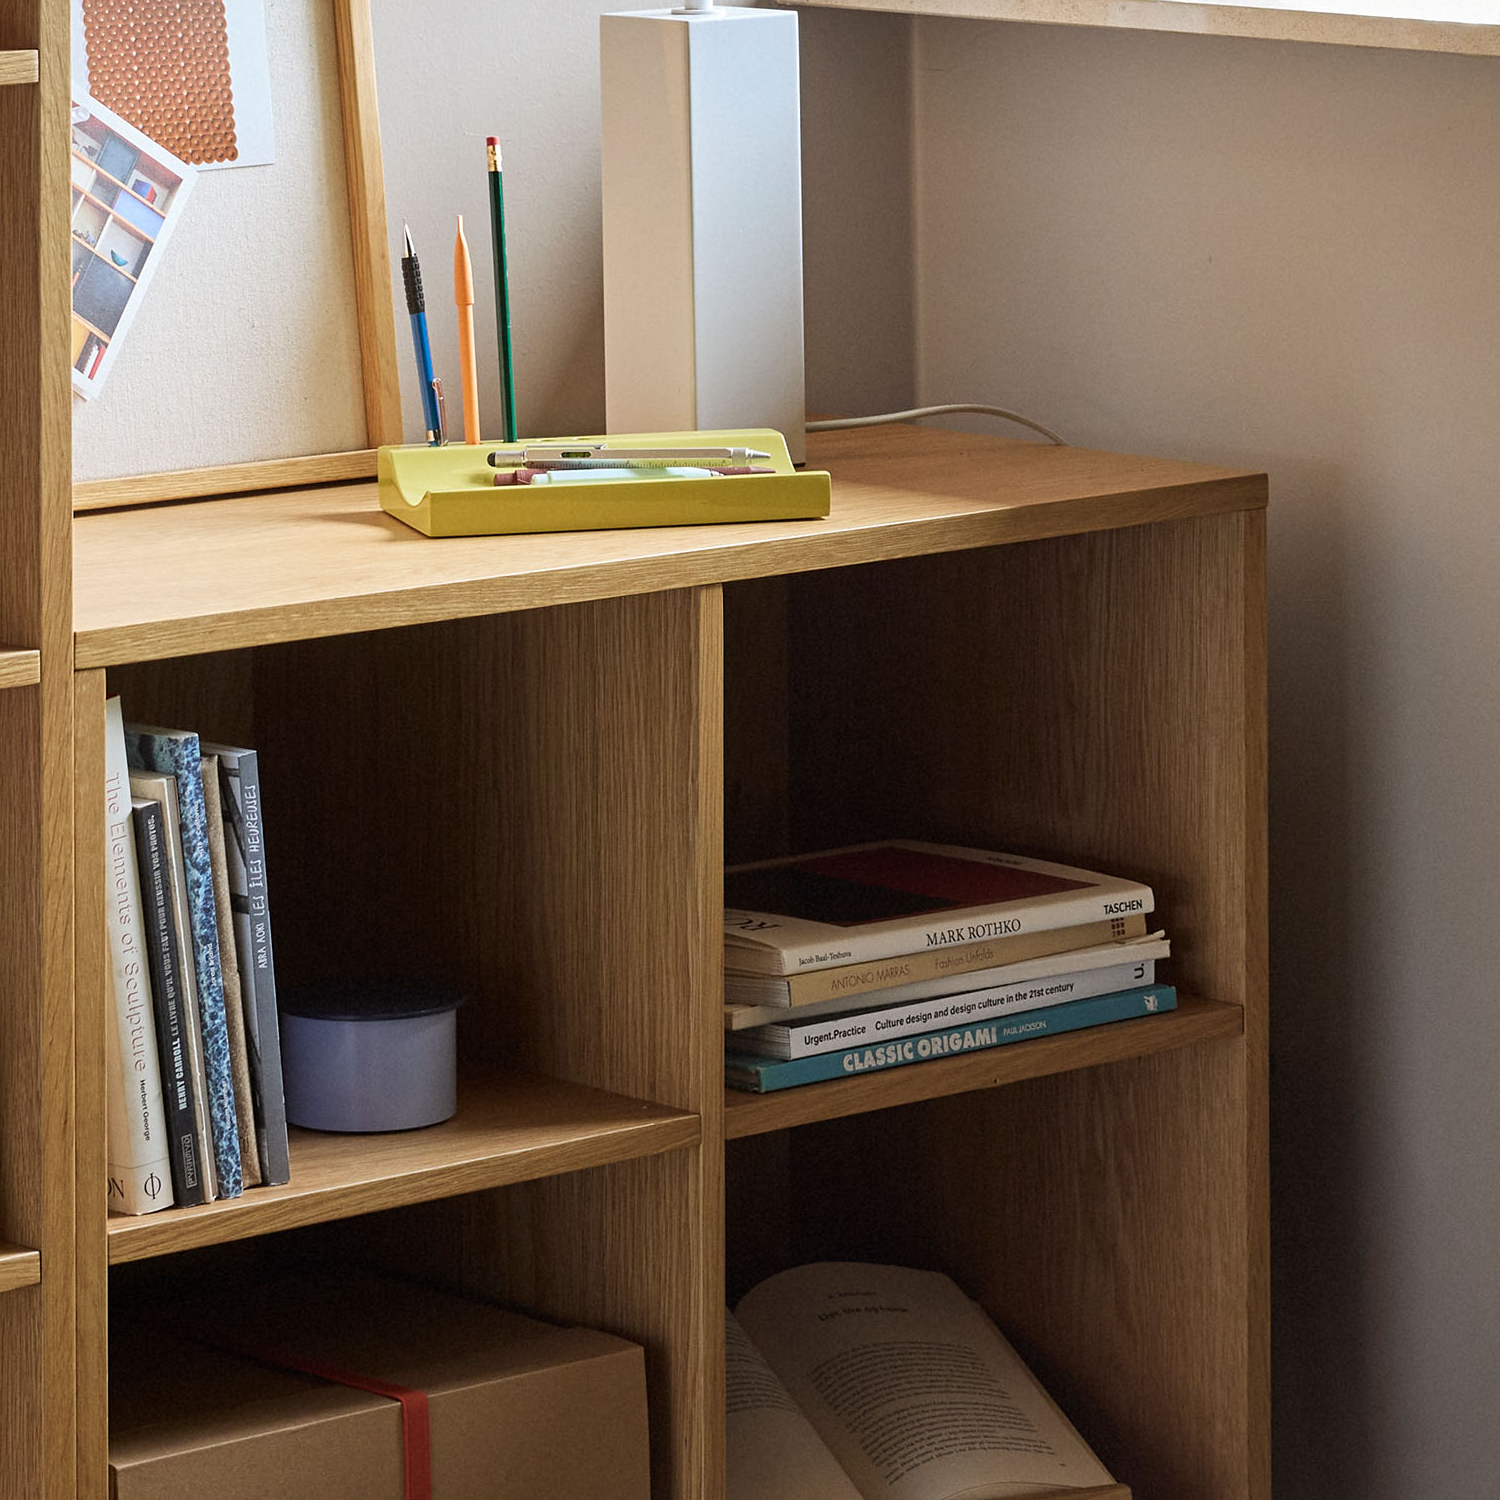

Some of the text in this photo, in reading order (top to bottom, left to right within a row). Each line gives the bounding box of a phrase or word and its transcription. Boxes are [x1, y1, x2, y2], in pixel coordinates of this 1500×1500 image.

[244, 784, 260, 852] HEUREUSES
[150, 851, 162, 871] VOS
[157, 907, 168, 930] POUR
[252, 895, 266, 916] LES
[1103, 898, 1143, 915] TASCHEN
[106, 772, 146, 1072] The Elements of Sculpture
[926, 918, 1022, 947] MARK ROTHKO
[160, 931, 170, 952] FAUT
[162, 953, 173, 976] VOUS
[934, 948, 996, 971] Fashion Unfolds
[165, 976, 176, 999] QU'IL
[830, 964, 910, 991] ANTONIO MARRAS
[167, 999, 178, 1025] LIVRE
[804, 981, 1075, 1046] Urgent.Practice Culture design and design culture in the 21st century
[170, 1025, 179, 1037] LE
[172, 1037, 185, 1079] CARROLL
[843, 1020, 1047, 1073] CLASSIC ORIGAMI PAUL JACKSON
[176, 1080, 188, 1110] HENRY
[139, 1079, 151, 1141] Herbert George
